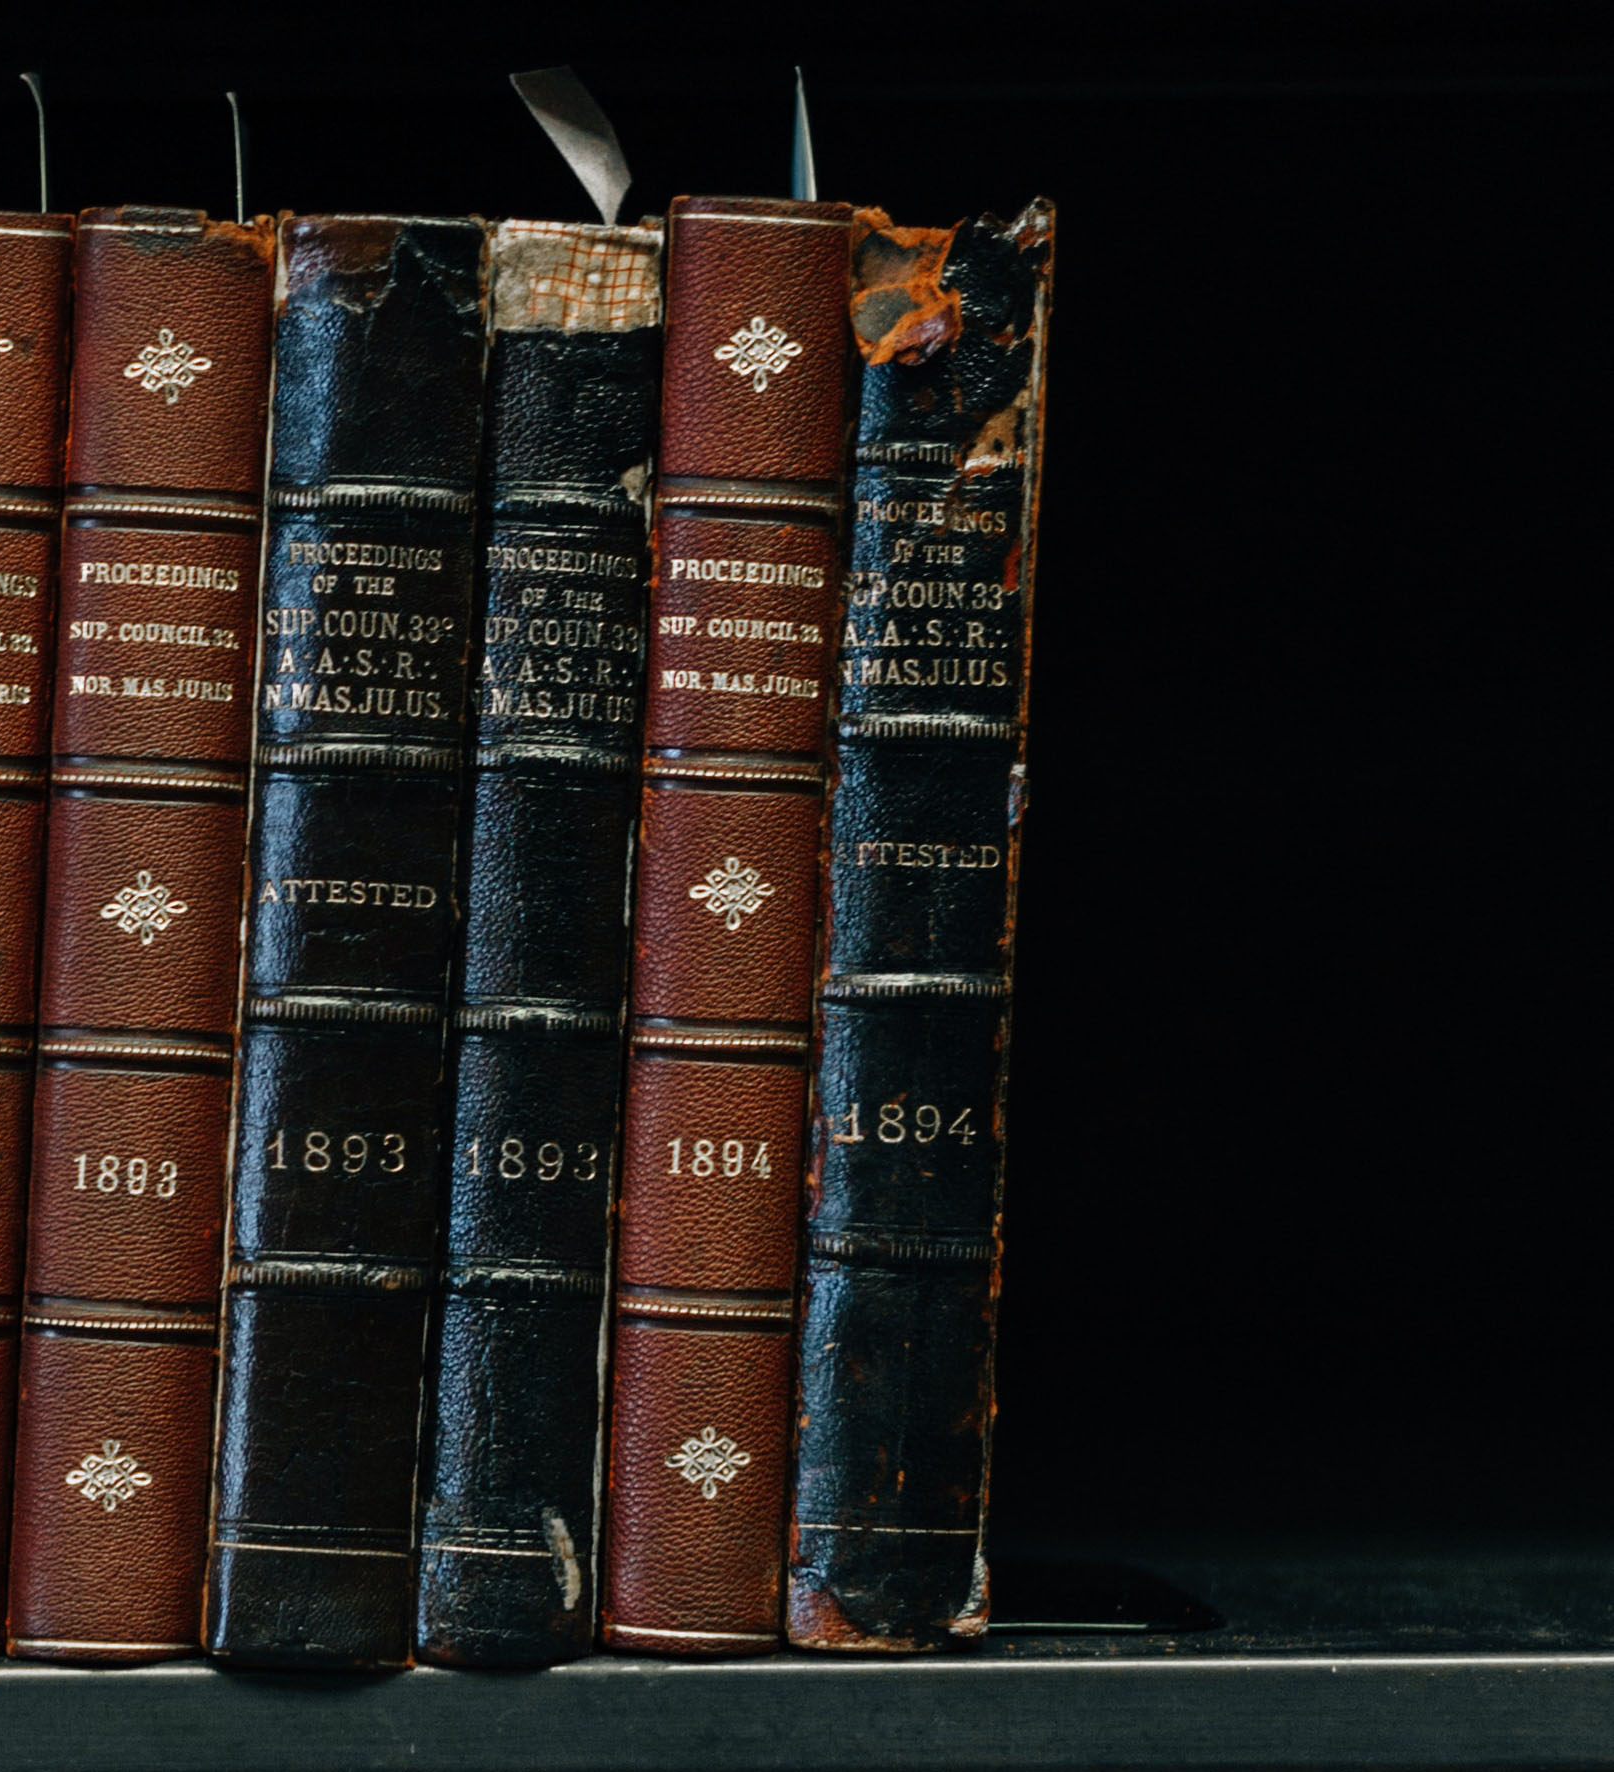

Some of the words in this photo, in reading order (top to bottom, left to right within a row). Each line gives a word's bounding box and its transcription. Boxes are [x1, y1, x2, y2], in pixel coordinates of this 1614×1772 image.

[288, 541, 443, 571] PROCEEDINGS
[485, 545, 638, 579] PROCEEDINGS
[922, 544, 966, 565] THE
[79, 562, 239, 591] PROCEEDINGS
[312, 574, 339, 594] OF
[352, 575, 396, 596] THE
[669, 559, 825, 589] PROCEEDINGS
[521, 587, 548, 607] OF
[561, 589, 606, 612] THE
[118, 622, 210, 647] COUNCIL
[707, 618, 798, 641] COUNCIL
[172, 678, 234, 702] JURIS
[761, 674, 820, 698] JURIS
[258, 879, 438, 909] ATTESTED
[836, 1101, 978, 1146] 1894
[265, 1128, 407, 1174] 1893
[463, 1135, 600, 1182] 1893
[665, 1137, 773, 1181] 1894
[72, 1153, 179, 1198] 1893
